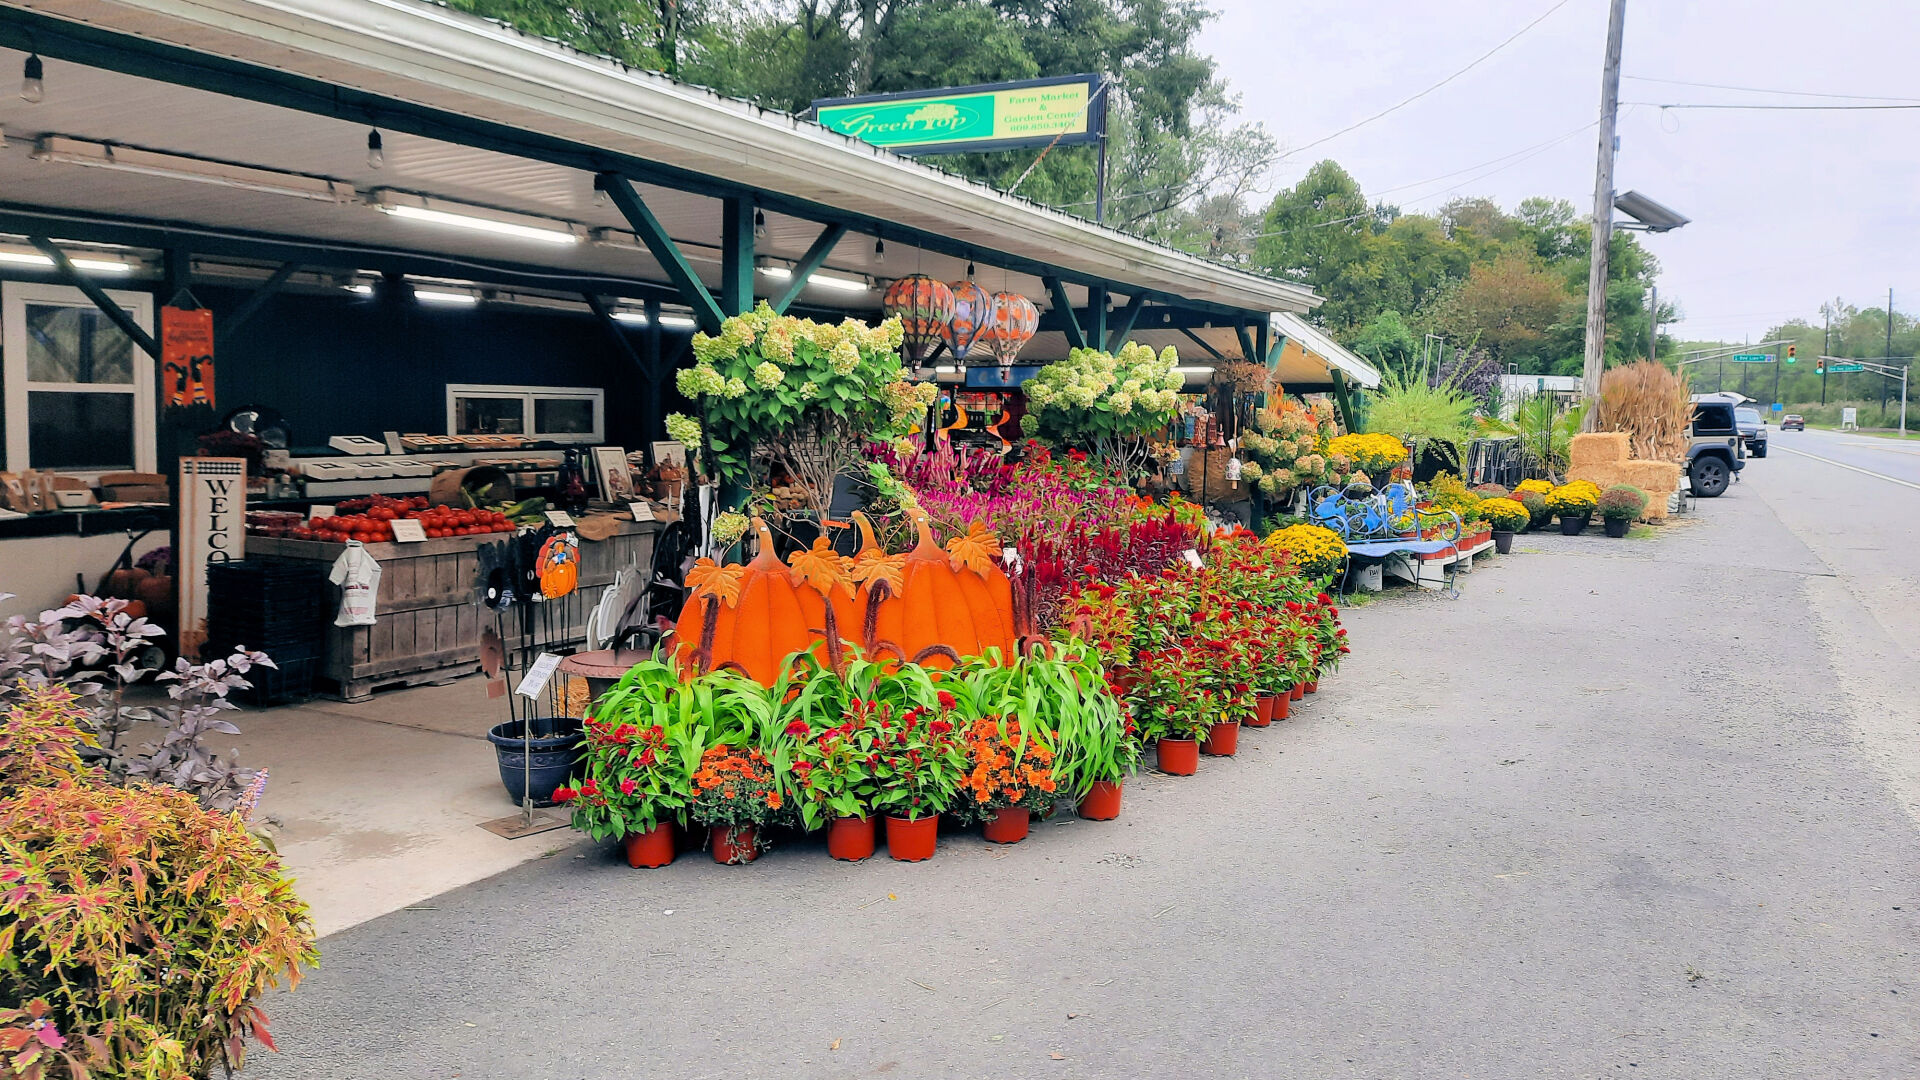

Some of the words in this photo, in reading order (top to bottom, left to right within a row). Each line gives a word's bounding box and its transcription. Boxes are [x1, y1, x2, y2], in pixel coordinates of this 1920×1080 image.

[1009, 96, 1037, 104] Farm
[1041, 92, 1079, 102] Market
[1039, 103, 1047, 111] &
[1004, 113, 1043, 123] Garden
[841, 114, 915, 136] Green
[921, 112, 967, 131] Top
